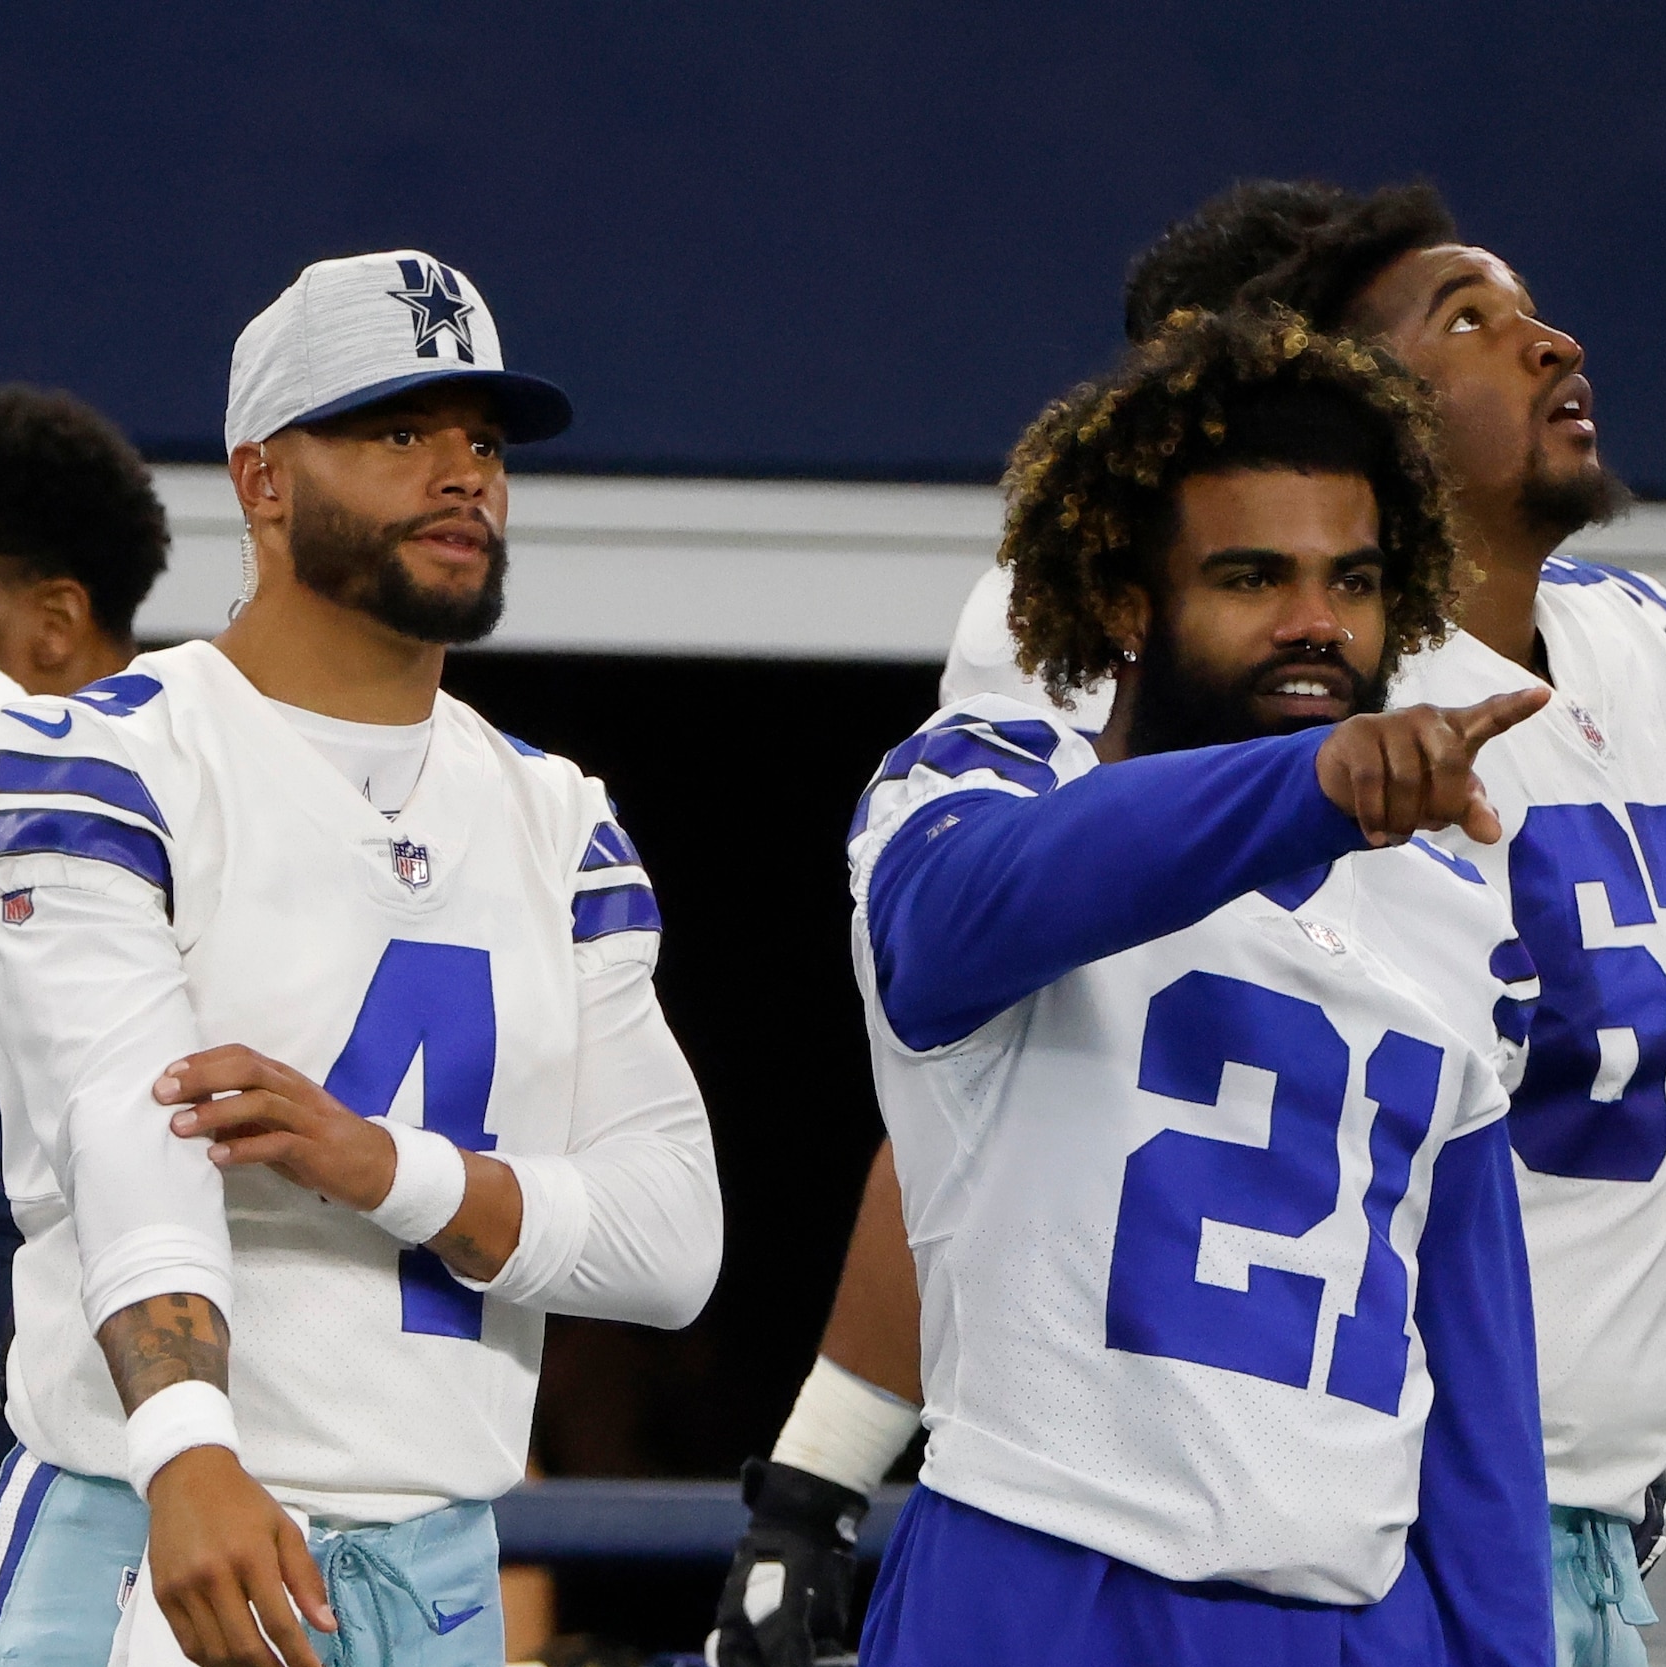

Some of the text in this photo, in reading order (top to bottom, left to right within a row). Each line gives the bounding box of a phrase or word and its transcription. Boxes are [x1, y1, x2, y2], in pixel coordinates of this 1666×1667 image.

[398, 857, 426, 881] NFL
[325, 939, 498, 1341] 4
[1106, 970, 1445, 1417] 21
